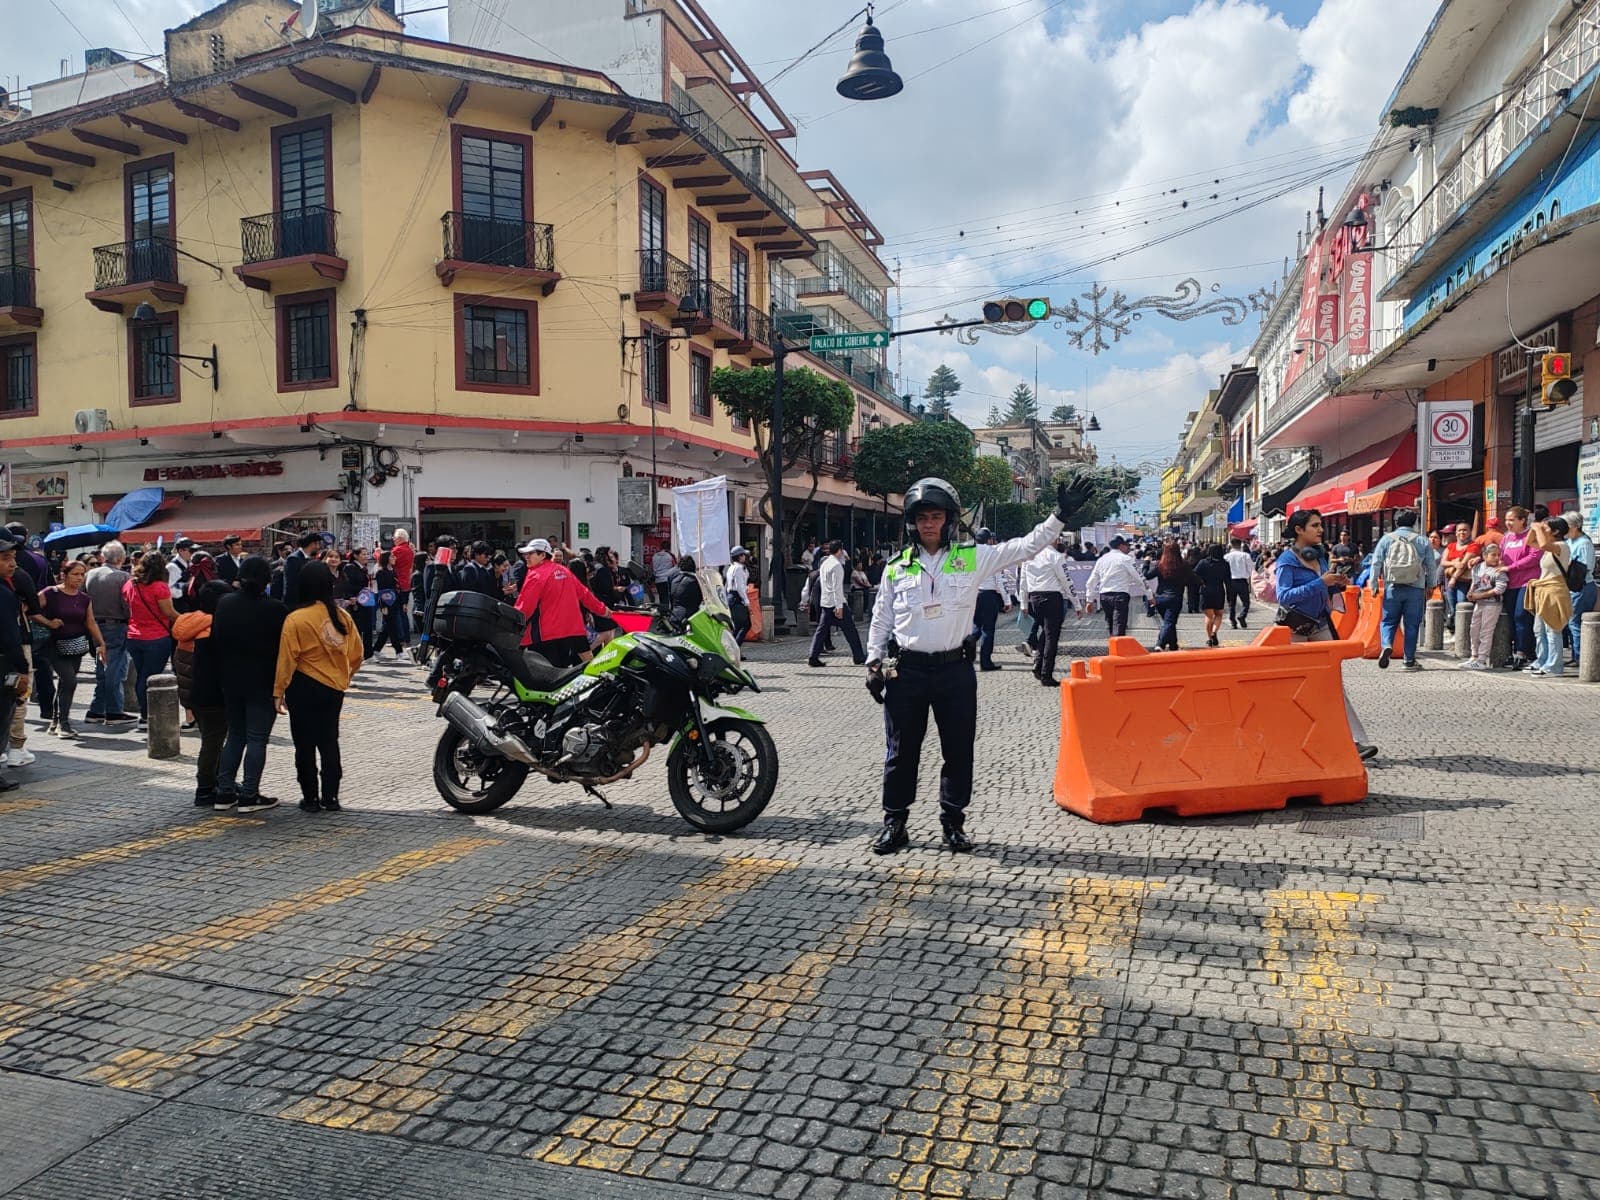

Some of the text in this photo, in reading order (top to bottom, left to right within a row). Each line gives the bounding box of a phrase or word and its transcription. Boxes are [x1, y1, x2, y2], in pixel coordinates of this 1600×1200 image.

[1349, 260, 1367, 340] SEARS
[814, 335, 870, 349] PALACIO DE GOBIERNO
[1318, 300, 1335, 355] SEAR
[1442, 418, 1459, 433] 30
